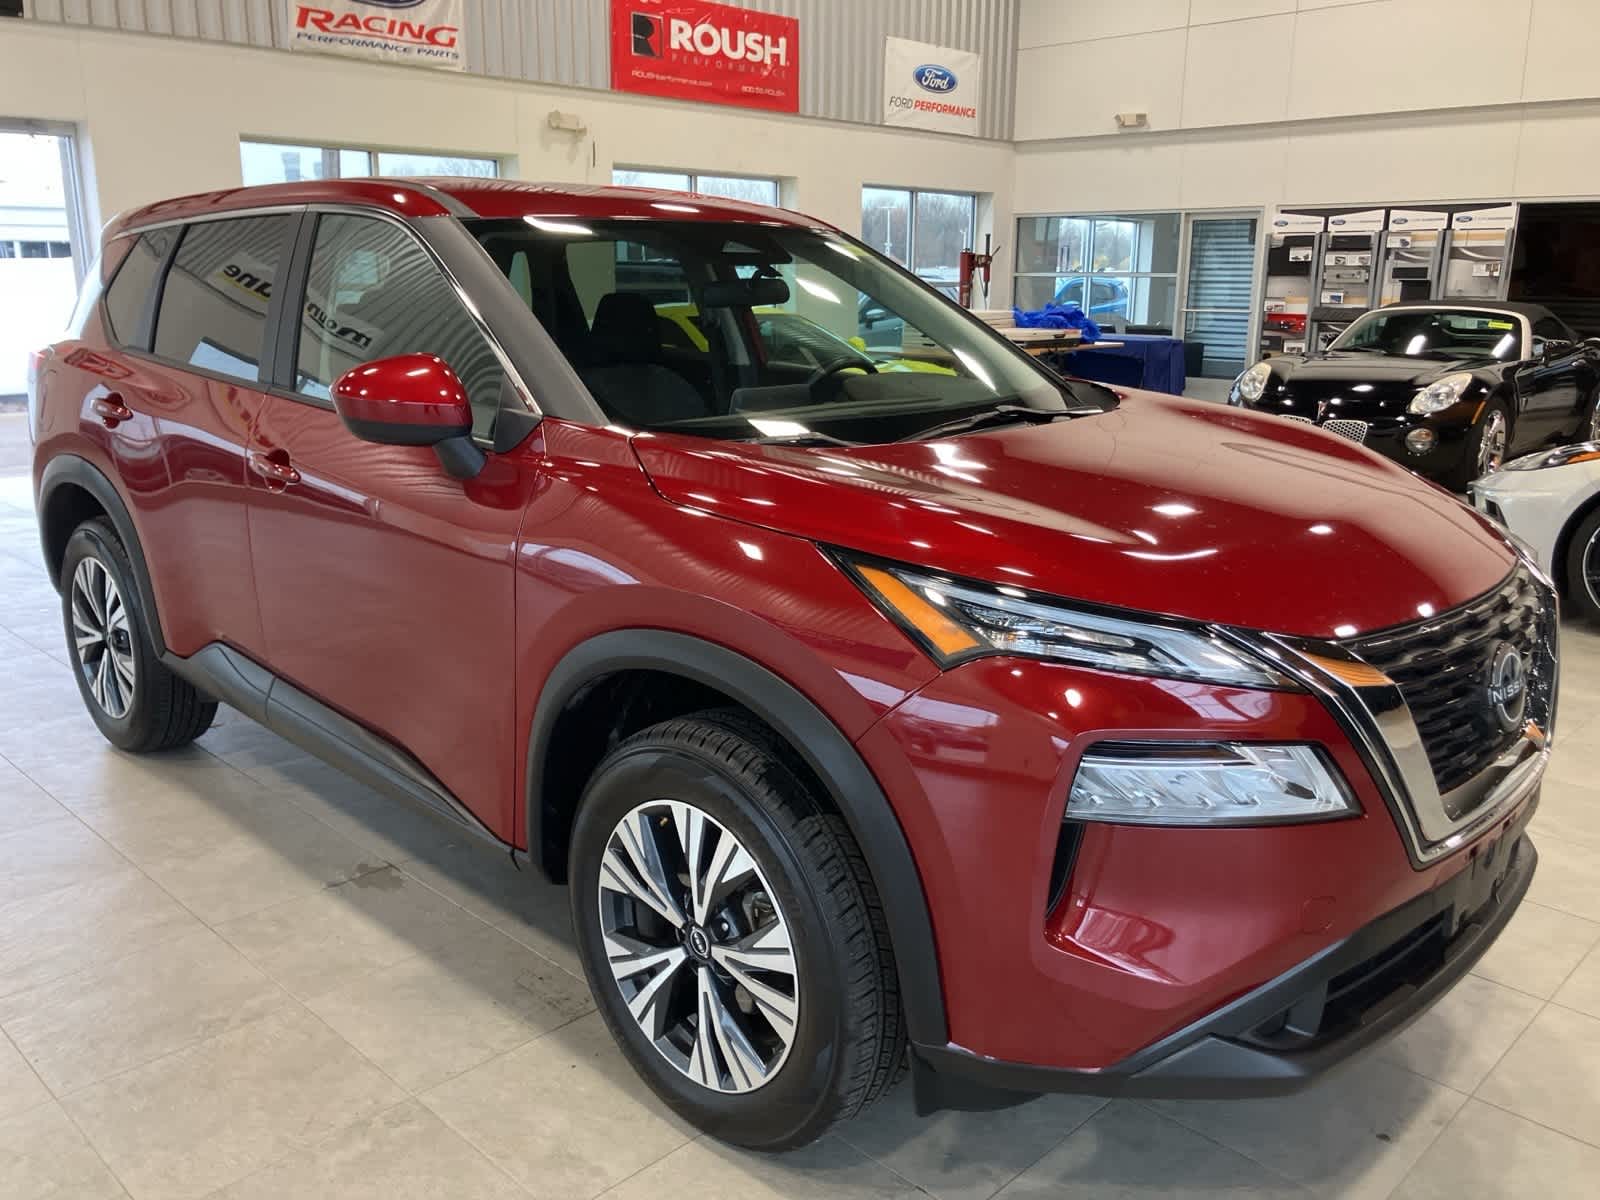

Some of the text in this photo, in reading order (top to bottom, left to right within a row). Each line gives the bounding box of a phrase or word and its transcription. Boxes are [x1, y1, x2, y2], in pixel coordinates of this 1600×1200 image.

[296, 6, 459, 48] RACING
[297, 32, 460, 60] PERFORMANCE PARTS
[670, 17, 785, 67] ROUSH
[921, 68, 950, 90] Ford
[889, 96, 977, 118] FORD PERFORMANCE
[1492, 680, 1521, 703] NISS
